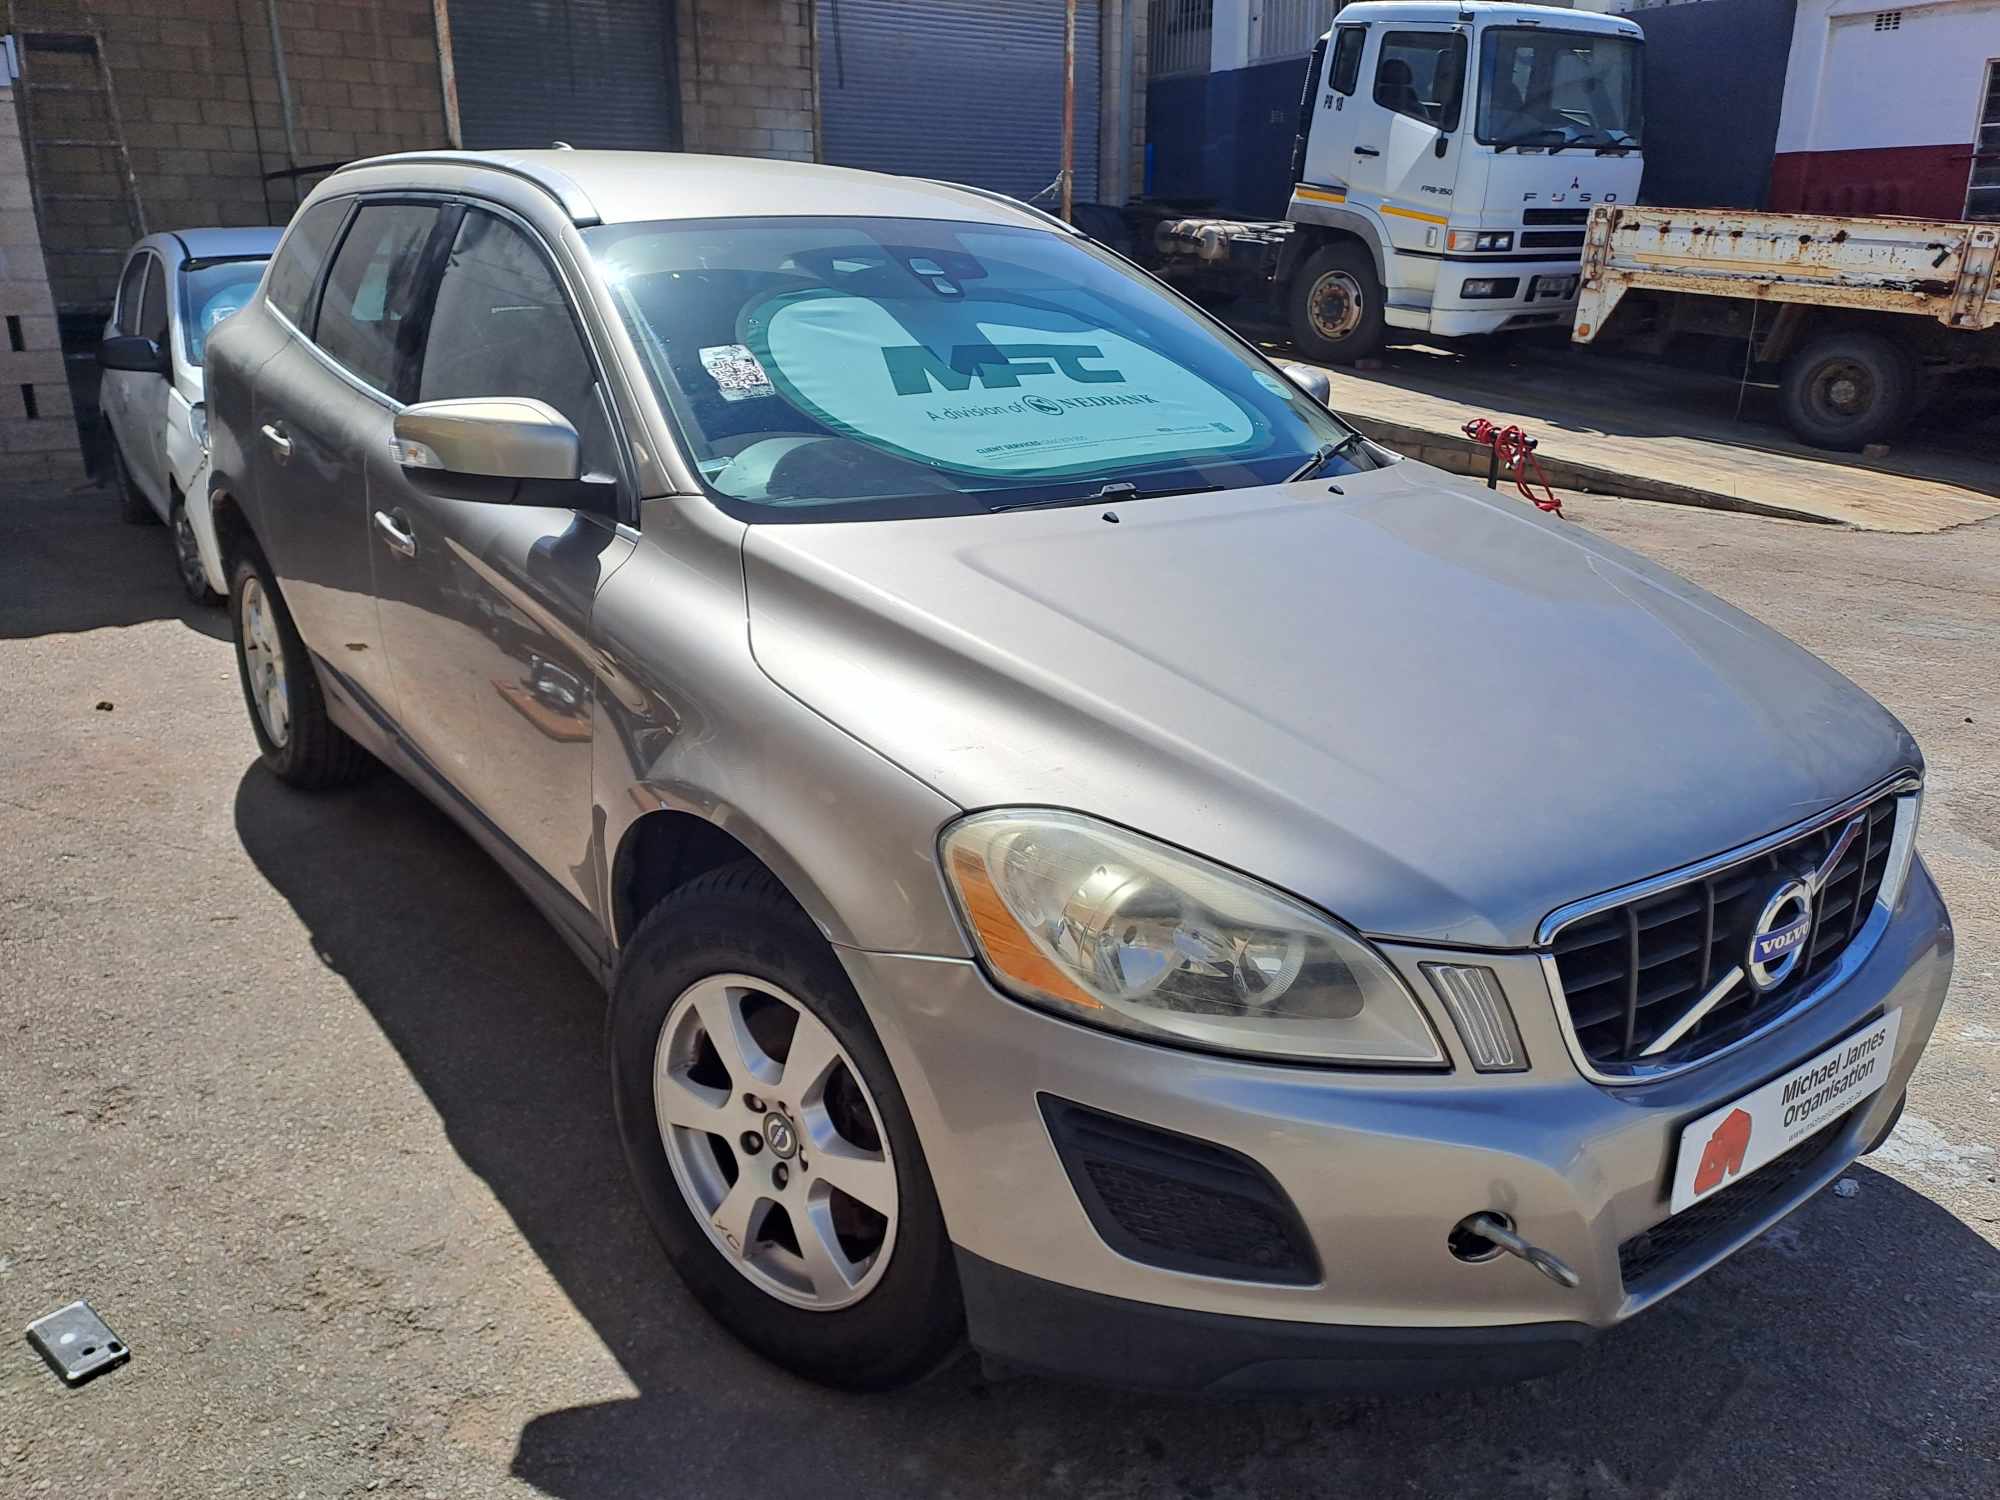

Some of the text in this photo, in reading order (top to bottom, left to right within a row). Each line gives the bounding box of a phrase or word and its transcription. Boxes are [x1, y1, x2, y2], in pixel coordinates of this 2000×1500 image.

[1522, 192, 1618, 203] FUSO
[880, 343, 1127, 396] MFC
[926, 394, 1160, 422] A division of NEDBANK
[1760, 921, 1809, 954] VOLVO
[1781, 1027, 1886, 1106] Michael James
[1783, 1056, 1876, 1129] Organisation
